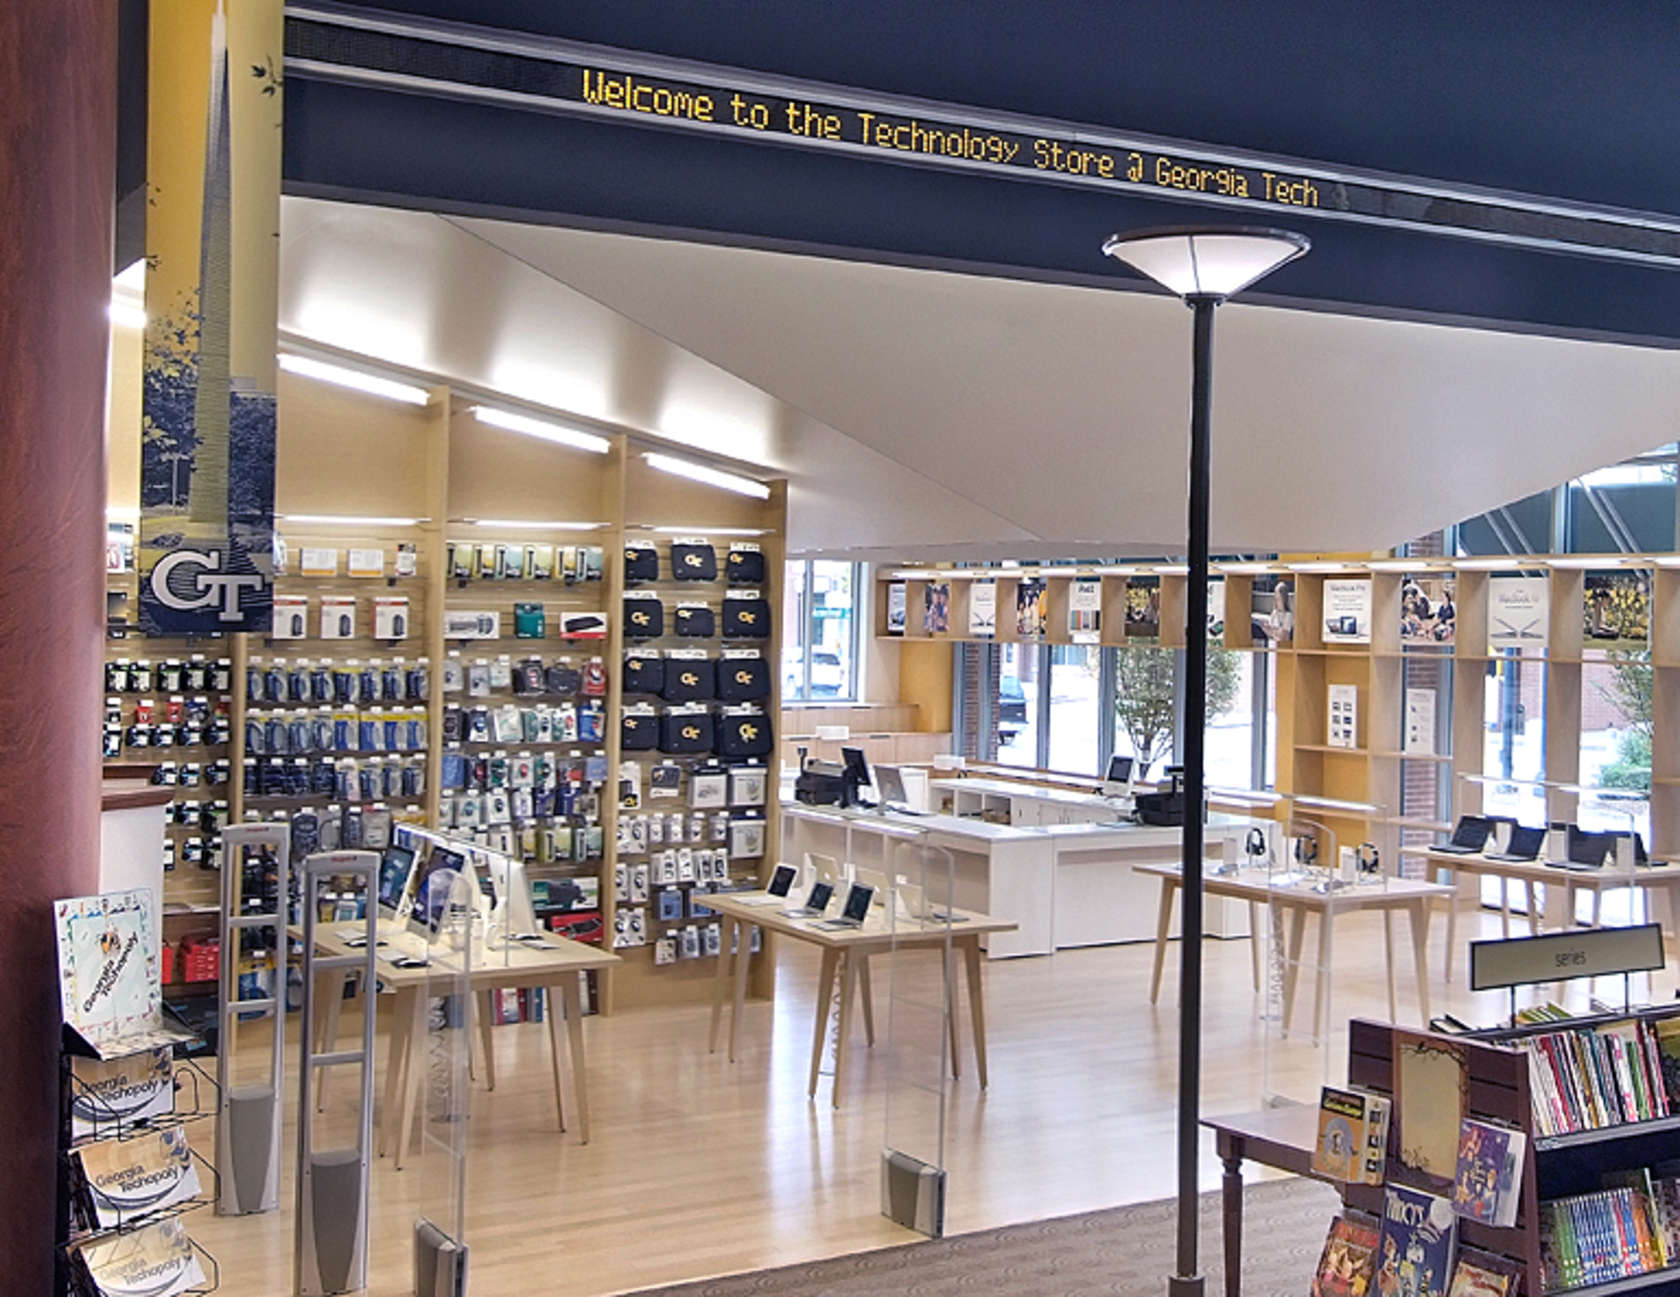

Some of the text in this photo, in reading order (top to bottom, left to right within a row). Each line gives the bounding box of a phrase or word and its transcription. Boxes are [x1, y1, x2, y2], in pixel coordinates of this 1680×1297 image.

[583, 69, 714, 121] Welcome
[731, 93, 769, 130] to
[785, 102, 841, 140] the
[857, 112, 1019, 163] Technology
[1033, 139, 1114, 178] Store
[1155, 157, 1250, 198] Georgia
[1262, 172, 1319, 207] Tech
[150, 550, 263, 622] GT
[1555, 947, 1586, 967] series
[83, 960, 114, 1013] Georgia
[96, 1164, 144, 1187] Georgia
